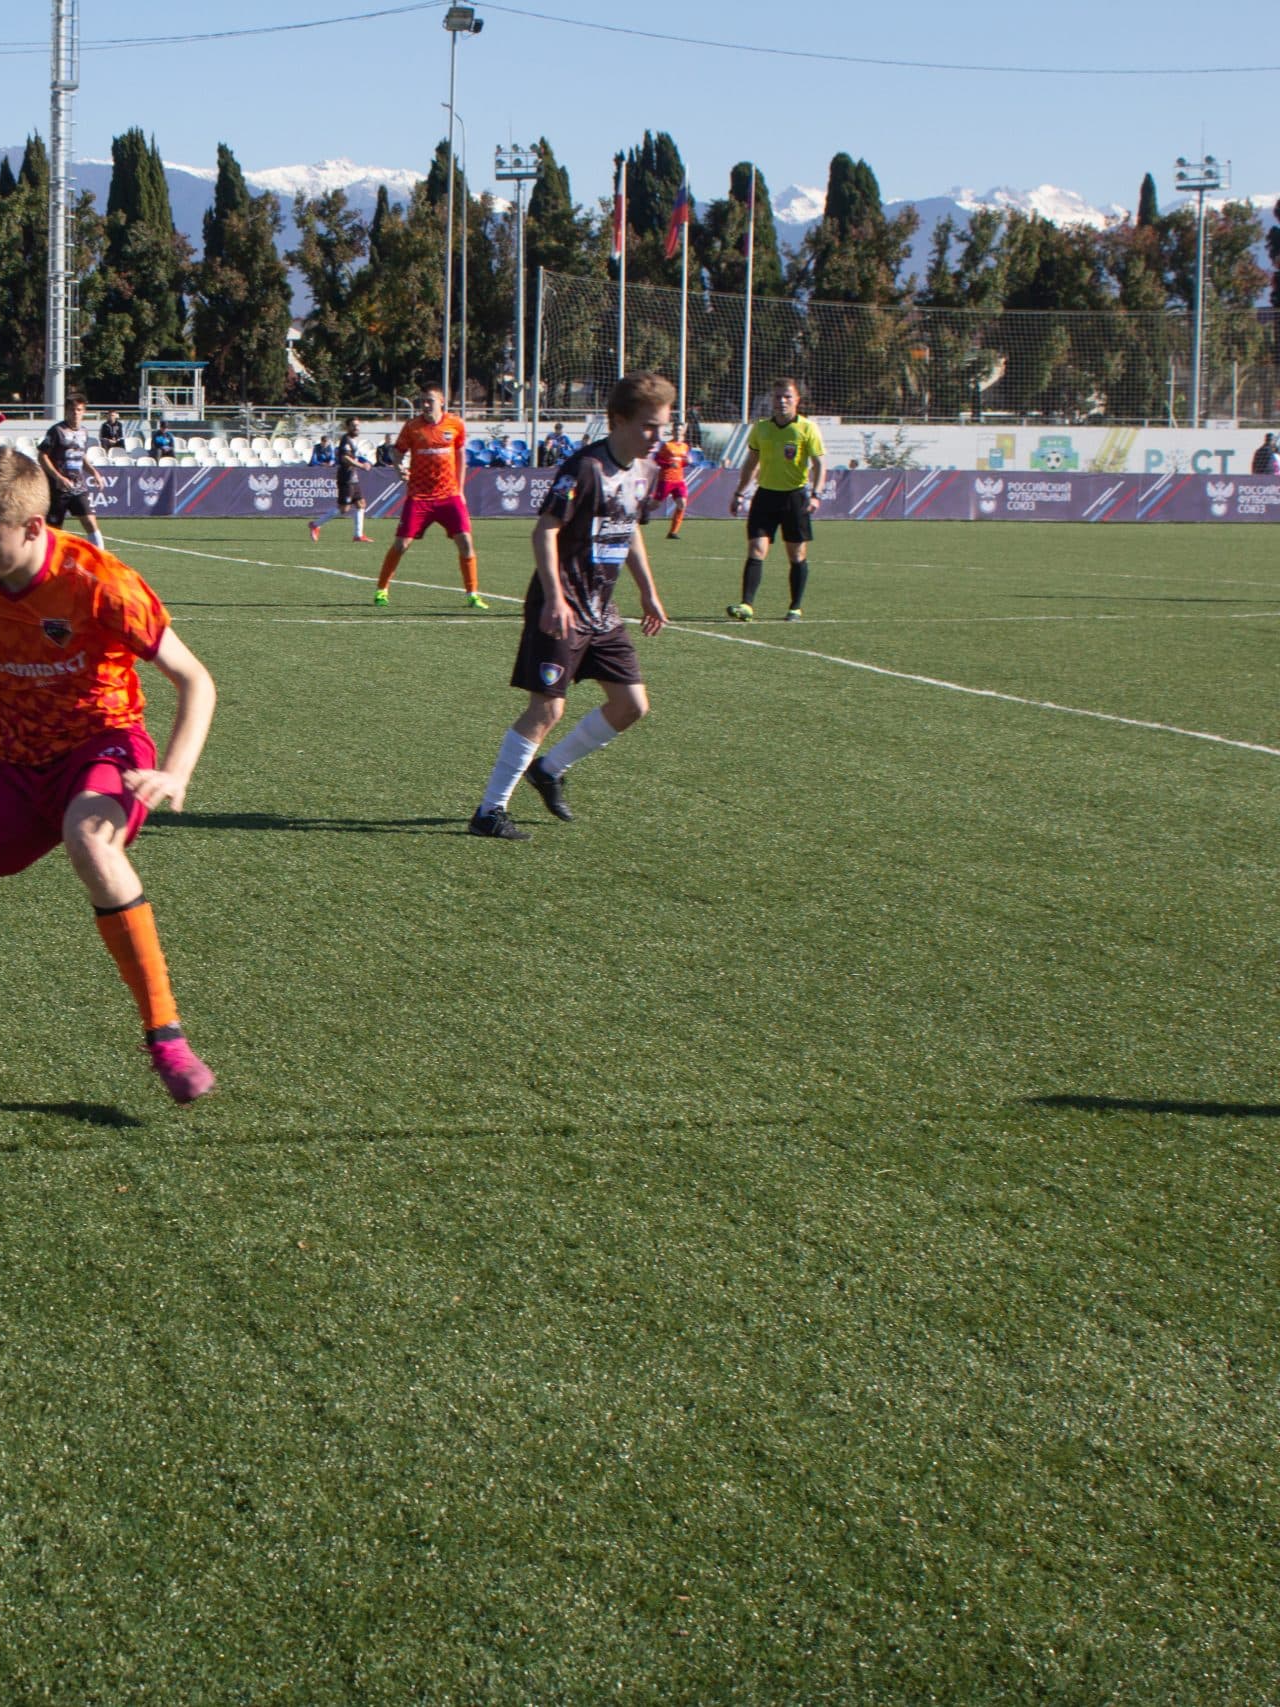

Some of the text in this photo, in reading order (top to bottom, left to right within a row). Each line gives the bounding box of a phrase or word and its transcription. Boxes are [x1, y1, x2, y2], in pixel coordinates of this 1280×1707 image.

[1007, 482, 1072, 492] РОССИЙСКИЙ
[1007, 492, 1072, 502] ФУТБОЛЬНЫЙ
[283, 498, 314, 508] СОЮЗ
[1007, 502, 1036, 511] СОЮЗ
[1238, 504, 1266, 514] СОЮЗ
